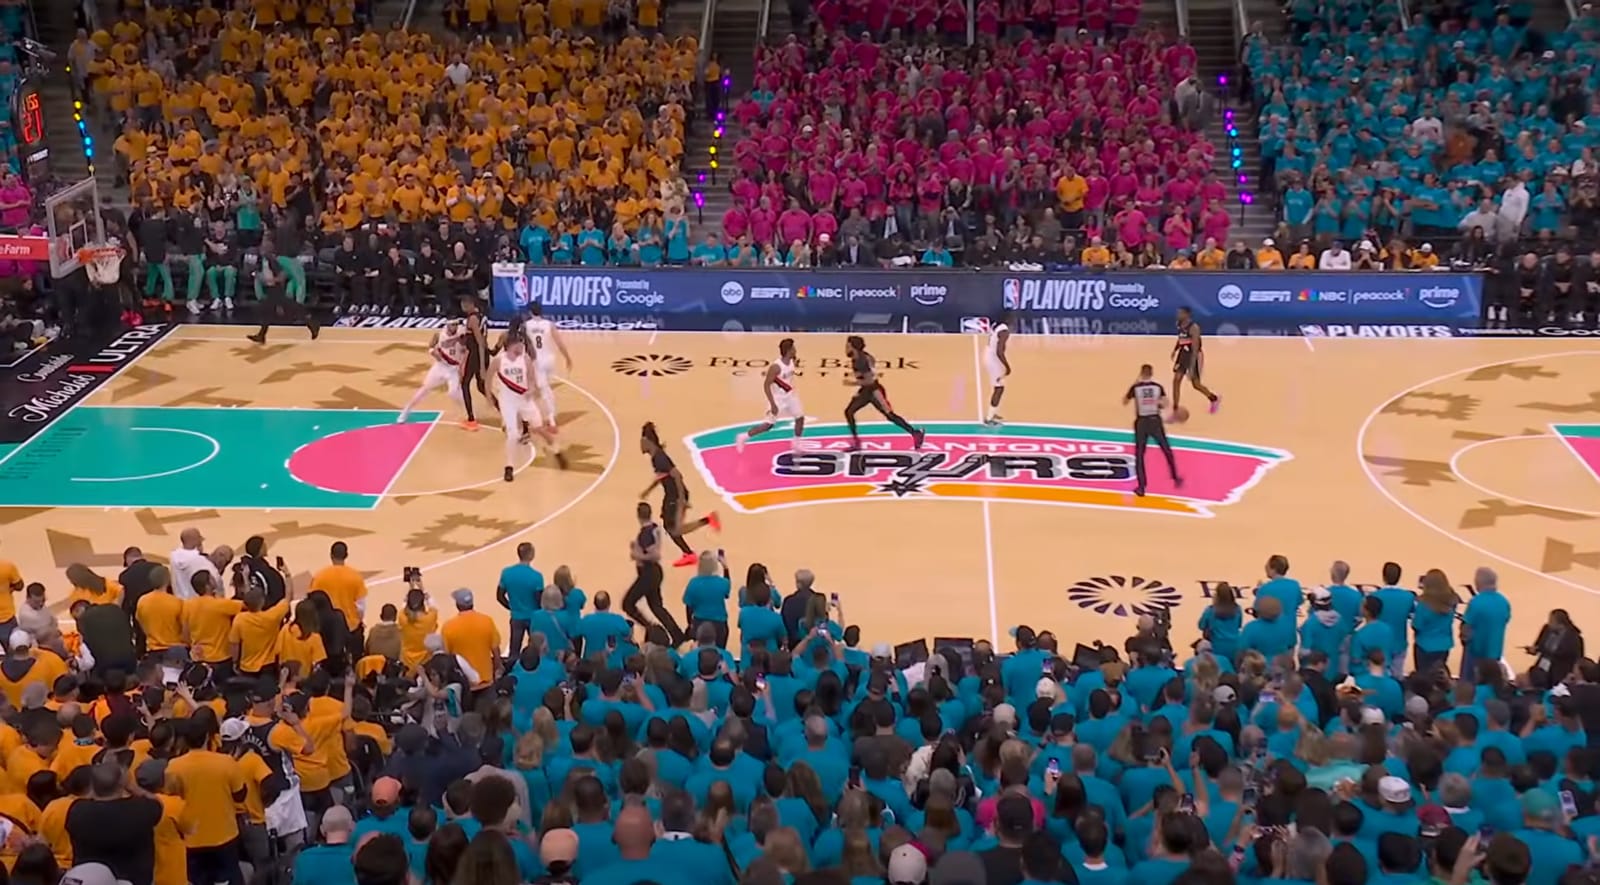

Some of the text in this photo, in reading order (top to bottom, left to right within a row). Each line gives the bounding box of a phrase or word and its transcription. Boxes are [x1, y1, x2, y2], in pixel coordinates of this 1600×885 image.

[531, 275, 613, 306] PLAYOFFS
[750, 287, 790, 299] ESPN
[816, 288, 842, 298] NBC
[850, 286, 897, 301] peacock
[910, 283, 947, 298] prime
[1020, 279, 1106, 310] PLAYOFFS
[1249, 290, 1291, 302] ESPN
[1318, 291, 1346, 301] NBC
[1353, 289, 1405, 304] peacock
[1419, 286, 1460, 301] prime
[616, 290, 665, 307] Google
[1109, 294, 1160, 311] Google
[355, 316, 467, 328] PLAYOF
[555, 320, 657, 330] Google
[1327, 325, 1454, 338] PLAYOFFS
[535, 335, 543, 349] 8
[708, 356, 807, 368] Frot
[8, 323, 168, 422] Michelob ULTRA
[797, 440, 1126, 453] SAN ANTONIO
[773, 451, 1137, 483] SPURS
